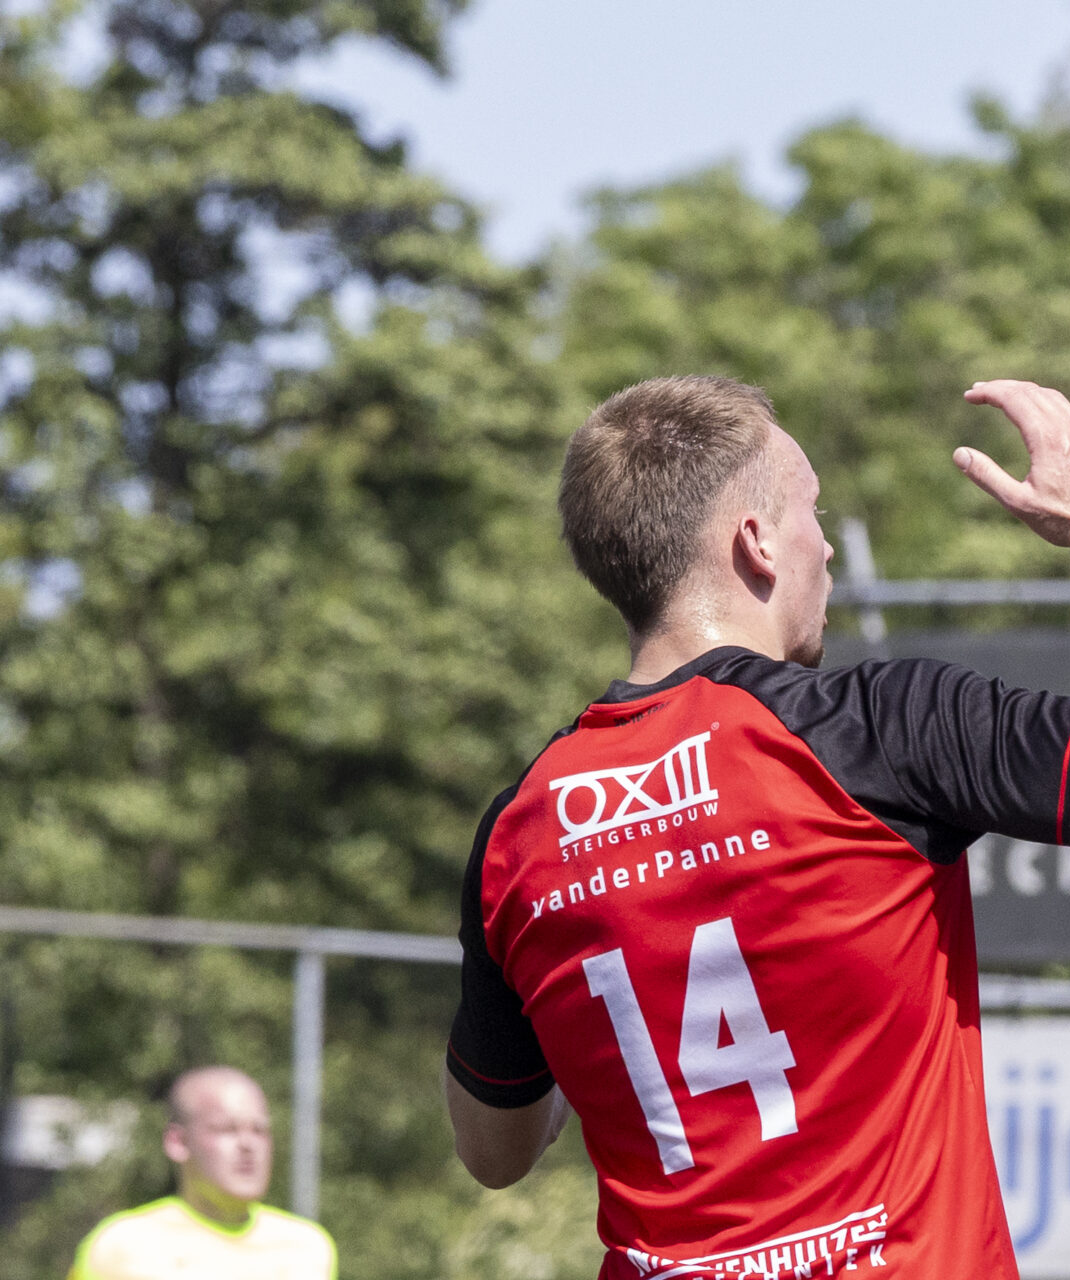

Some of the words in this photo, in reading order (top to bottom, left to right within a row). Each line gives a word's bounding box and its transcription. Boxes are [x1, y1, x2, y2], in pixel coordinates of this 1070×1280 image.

[532, 828, 771, 919] vanderPanne
[561, 802, 719, 862] STEIGERBOUW
[582, 916, 798, 1175] 14
